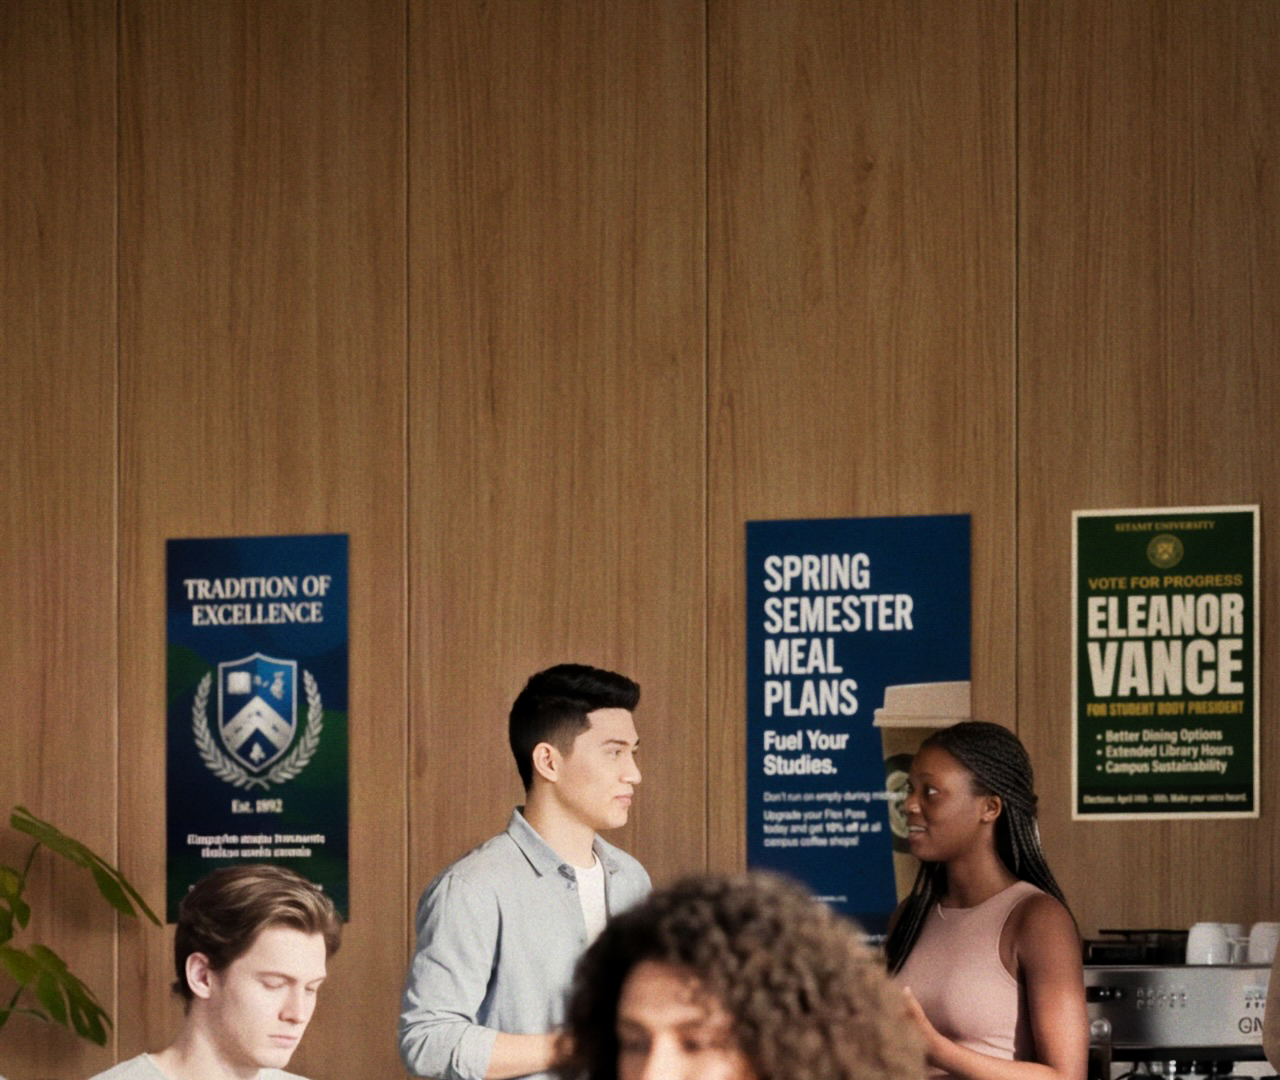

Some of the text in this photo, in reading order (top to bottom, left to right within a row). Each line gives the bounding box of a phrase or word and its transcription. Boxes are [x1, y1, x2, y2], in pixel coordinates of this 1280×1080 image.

[763, 553, 870, 593] SPRING
[1088, 574, 1243, 590] VOTE FOR PROGRESS
[184, 575, 331, 600] TRADITION OF
[192, 602, 323, 626] EXCELLENCE
[763, 594, 914, 634] SEMESTER
[1087, 593, 1244, 638] ELEANOR
[764, 637, 843, 676] MEAL
[1086, 639, 1245, 697] VANCE
[764, 679, 858, 717] PLANS
[763, 729, 849, 750] Fuel Your
[1105, 728, 1223, 744] Better Dining Options
[1105, 743, 1234, 759] Extended Library Hours
[763, 753, 837, 776] Studies.
[1105, 759, 1227, 775] Campus Sustainability
